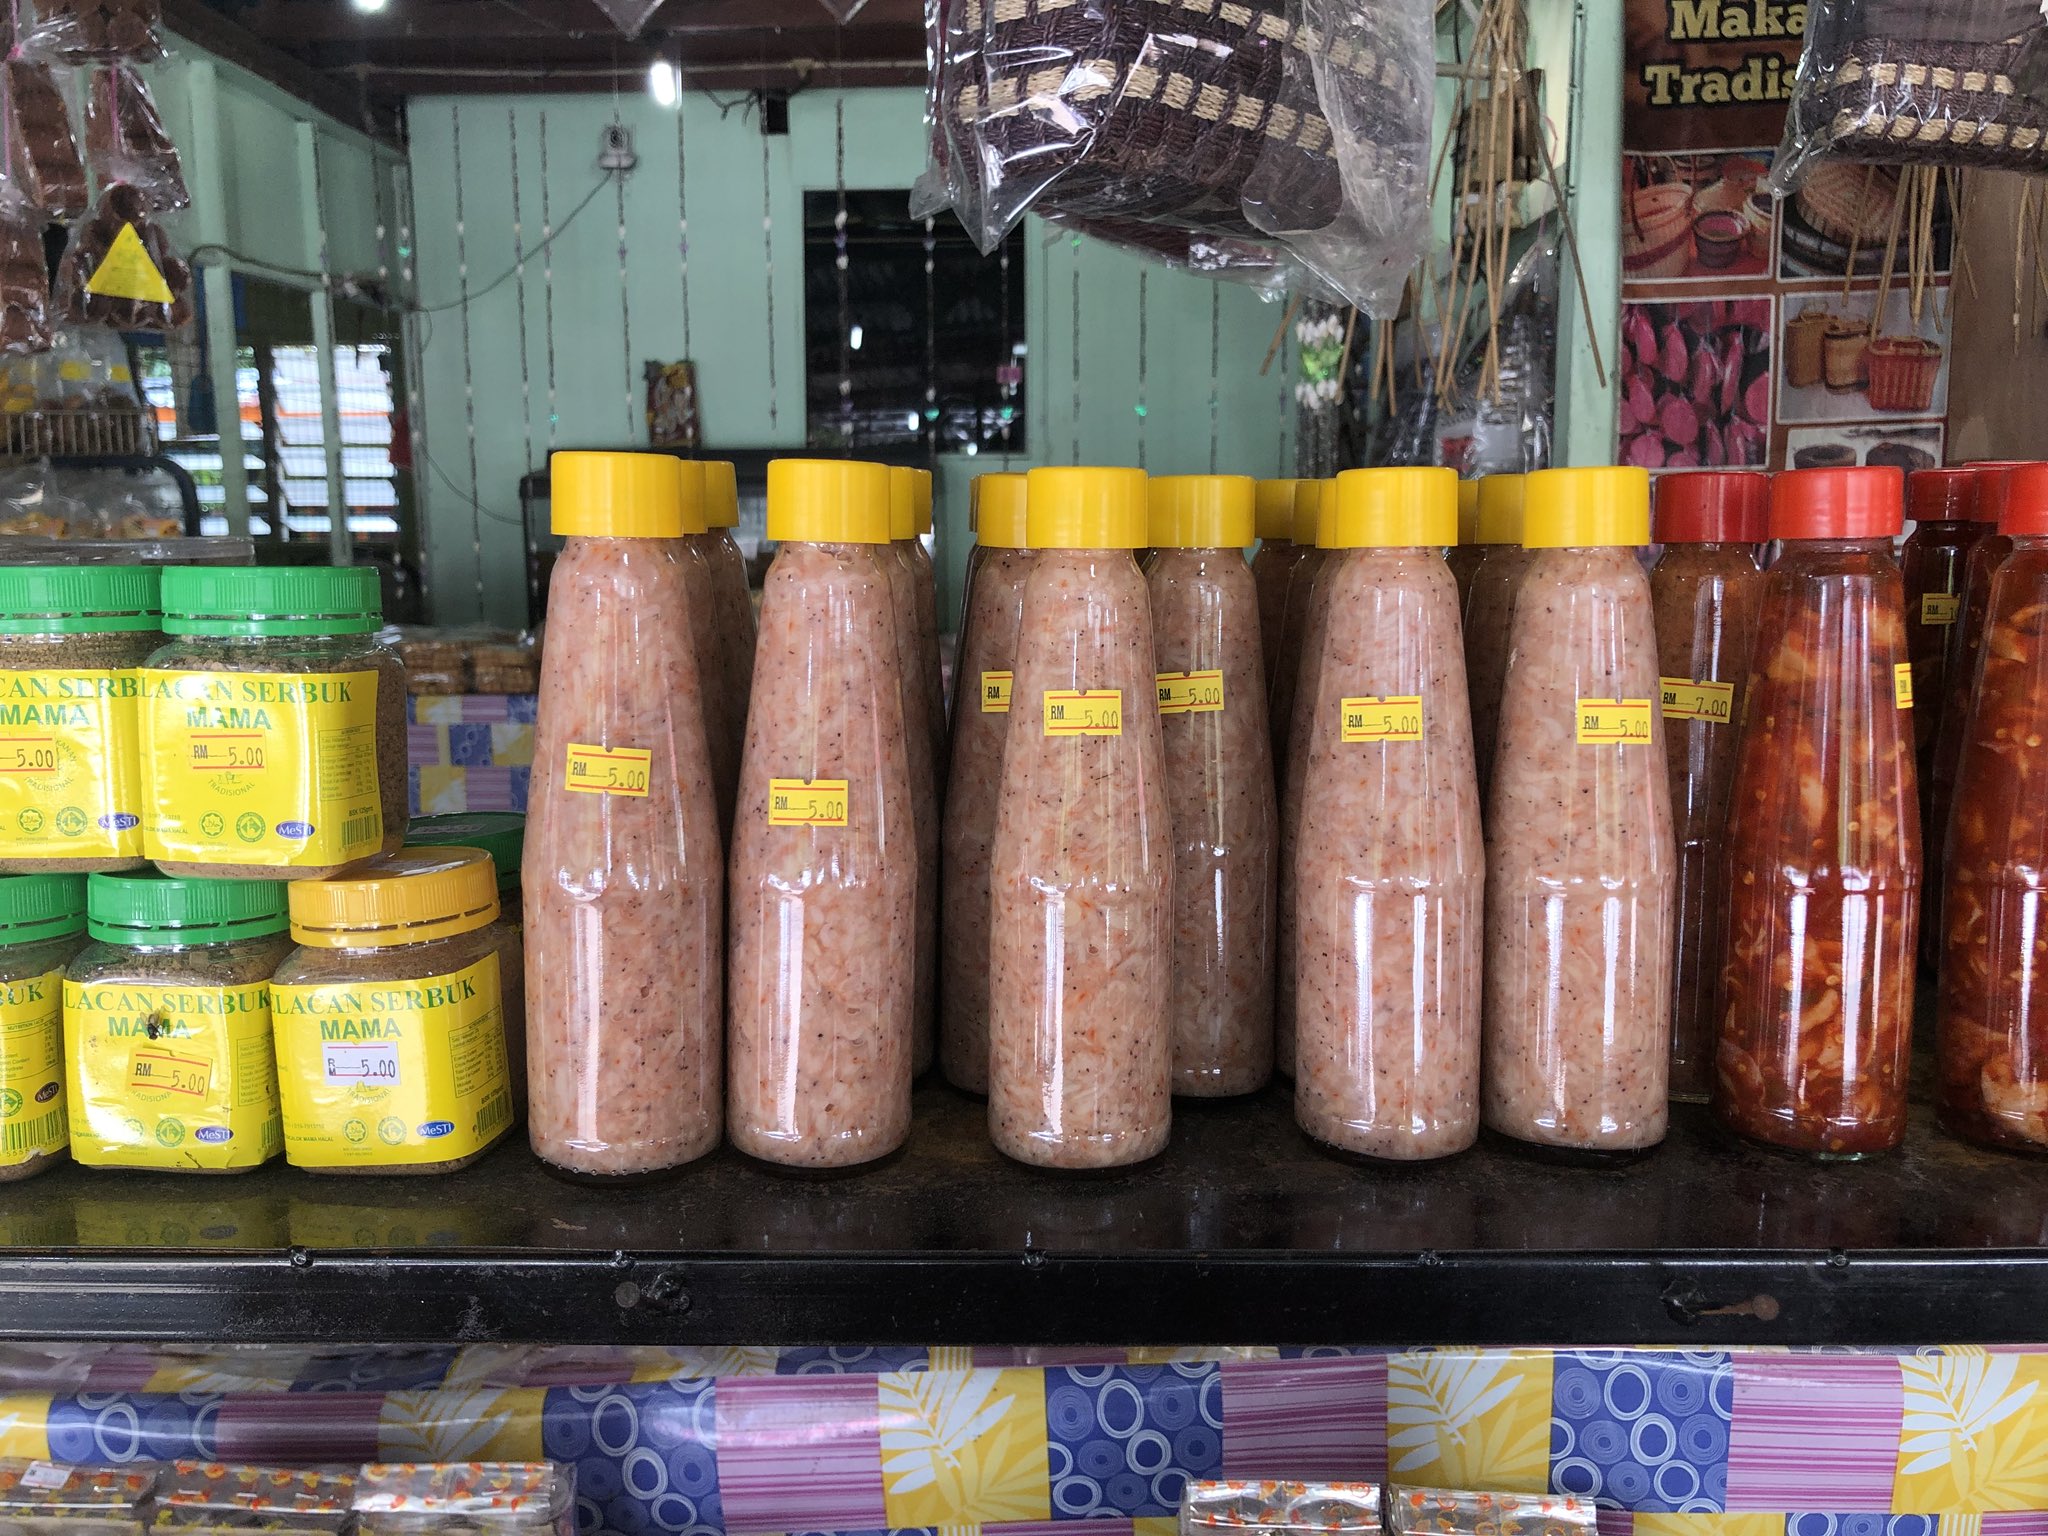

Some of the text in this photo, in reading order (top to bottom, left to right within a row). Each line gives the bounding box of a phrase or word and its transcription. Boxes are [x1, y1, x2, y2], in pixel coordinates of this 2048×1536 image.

[243, 681, 353, 704] SERBUK
[988, 686, 1000, 699] RM
[1159, 687, 1220, 705] RM 5.00
[0, 704, 90, 725] MAMA
[1663, 692, 1728, 717] RM 7.00
[187, 706, 272, 730] MAMA
[1051, 705, 1119, 729] RM 5.00
[1348, 714, 1418, 734] RM 5.00
[1584, 715, 1649, 738] RM 5.00
[16, 748, 54, 768] 5.00
[194, 744, 263, 767] RM 5.00
[207, 777, 255, 797] TRADISIONAL
[572, 761, 645, 790] RM 5.00
[774, 796, 844, 820] RM 5.00
[0, 981, 44, 1006] UK
[65, 987, 270, 1015] LACAN SERBUK
[371, 976, 476, 1014] SERBUK
[320, 1017, 402, 1040] MAMA
[135, 1062, 205, 1093] RM 5.00
[360, 1058, 396, 1078] 5.00
[37, 1084, 59, 1101] MeSTI
[198, 1128, 232, 1141] MeSTI
[420, 1123, 452, 1137] MeSTI
